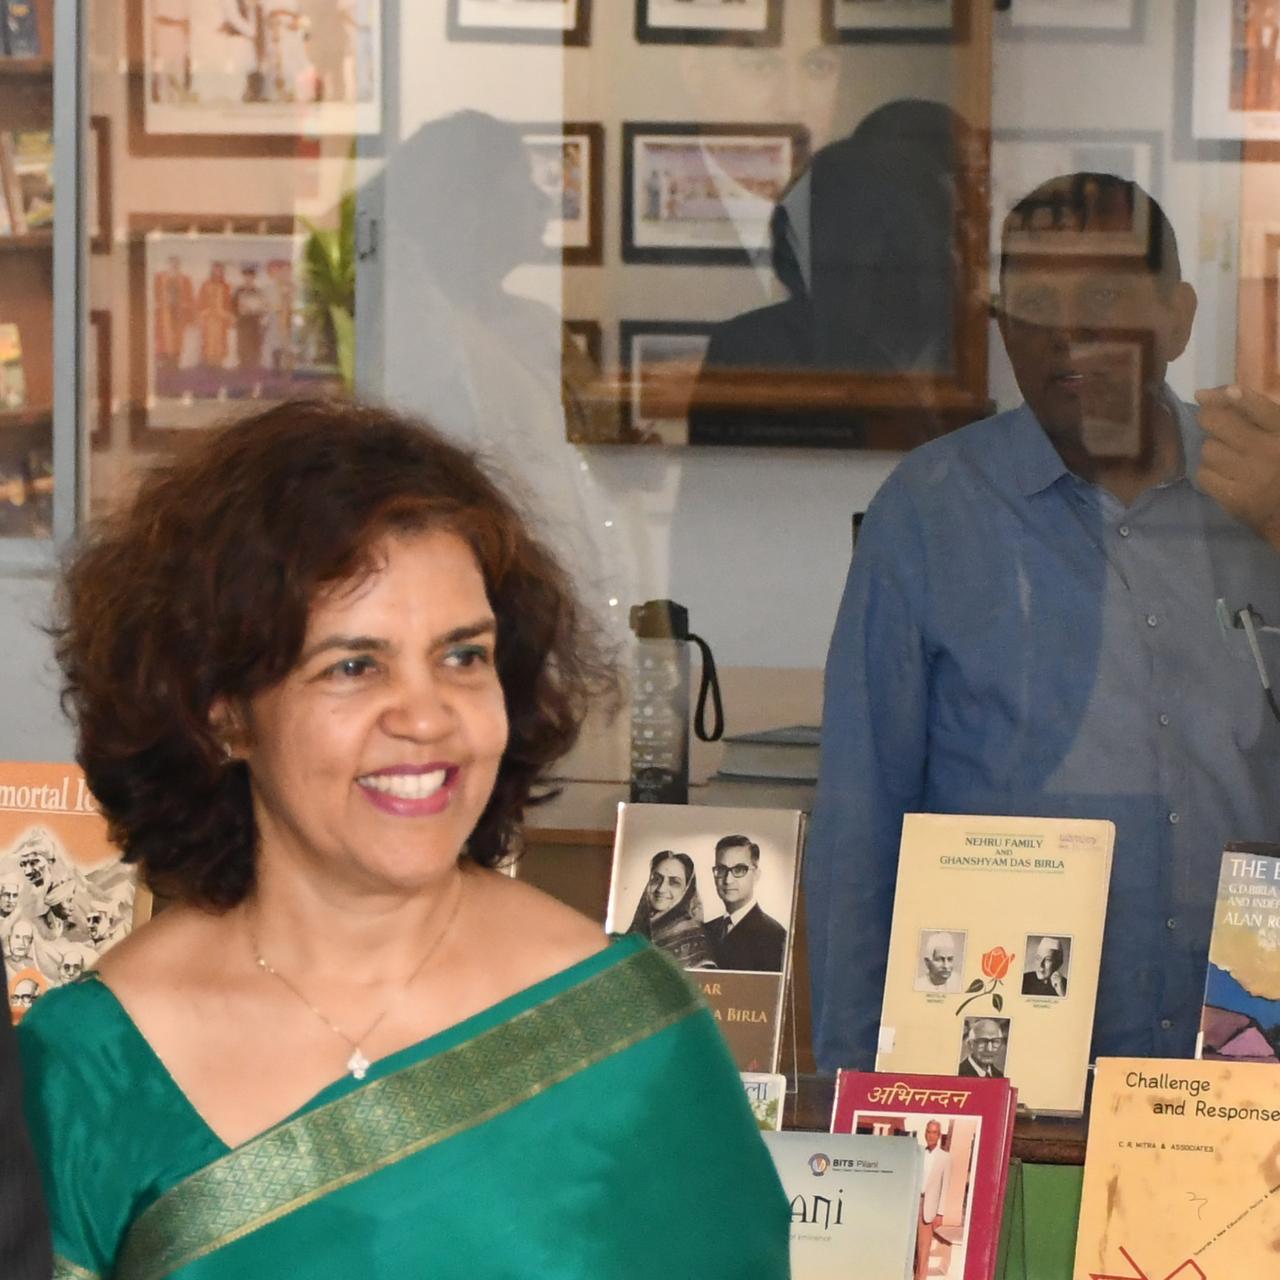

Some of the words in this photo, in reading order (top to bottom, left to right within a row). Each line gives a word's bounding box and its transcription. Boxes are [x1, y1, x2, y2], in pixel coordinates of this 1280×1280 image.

[965, 837, 1002, 847] NEHRU
[1004, 838, 1044, 849] FAMILY
[939, 855, 1008, 867] GHANSHYAM
[1010, 859, 1032, 868] DAS
[1034, 859, 1065, 869] BIRLA
[1230, 858, 1268, 879] THE
[1228, 897, 1250, 907] AND
[1223, 911, 1262, 928] ALAN
[699, 983, 722, 996] AR
[727, 1008, 768, 1023] BIRLA
[1125, 1072, 1211, 1097] Challenge
[868, 1081, 972, 1109] अभिनन्दन
[1153, 1100, 1186, 1116] and
[1195, 1100, 1280, 1122] Response
[1170, 1144, 1214, 1153] ASSOCIATES
[832, 1159, 854, 1167] BITS
